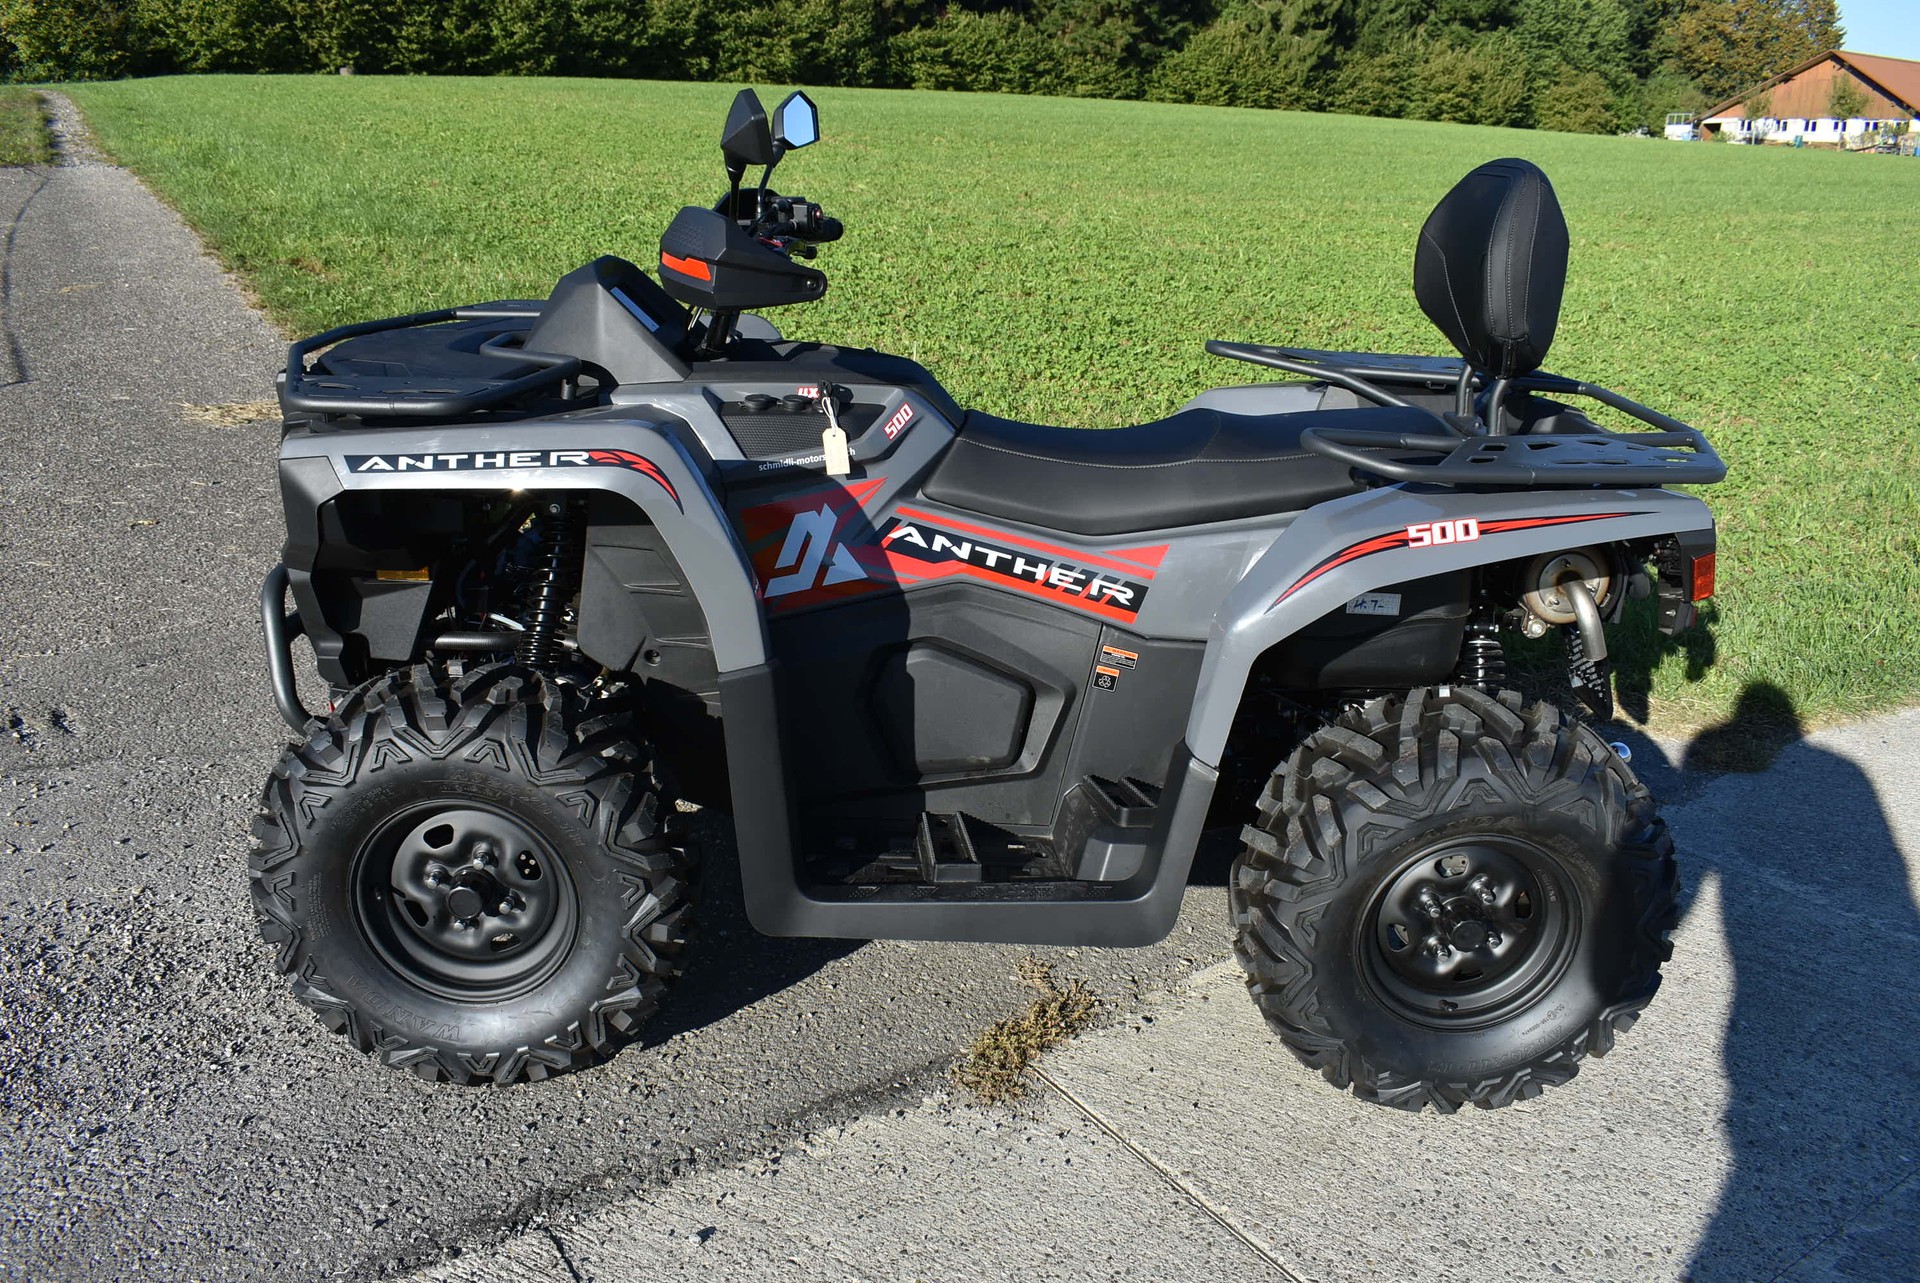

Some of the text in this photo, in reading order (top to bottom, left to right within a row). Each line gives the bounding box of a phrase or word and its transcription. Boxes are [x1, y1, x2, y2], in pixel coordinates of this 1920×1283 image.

[885, 404, 913, 440] 500
[357, 451, 589, 471] ANTHER
[1406, 518, 1479, 548] 500
[888, 526, 1134, 606] ANTHER
